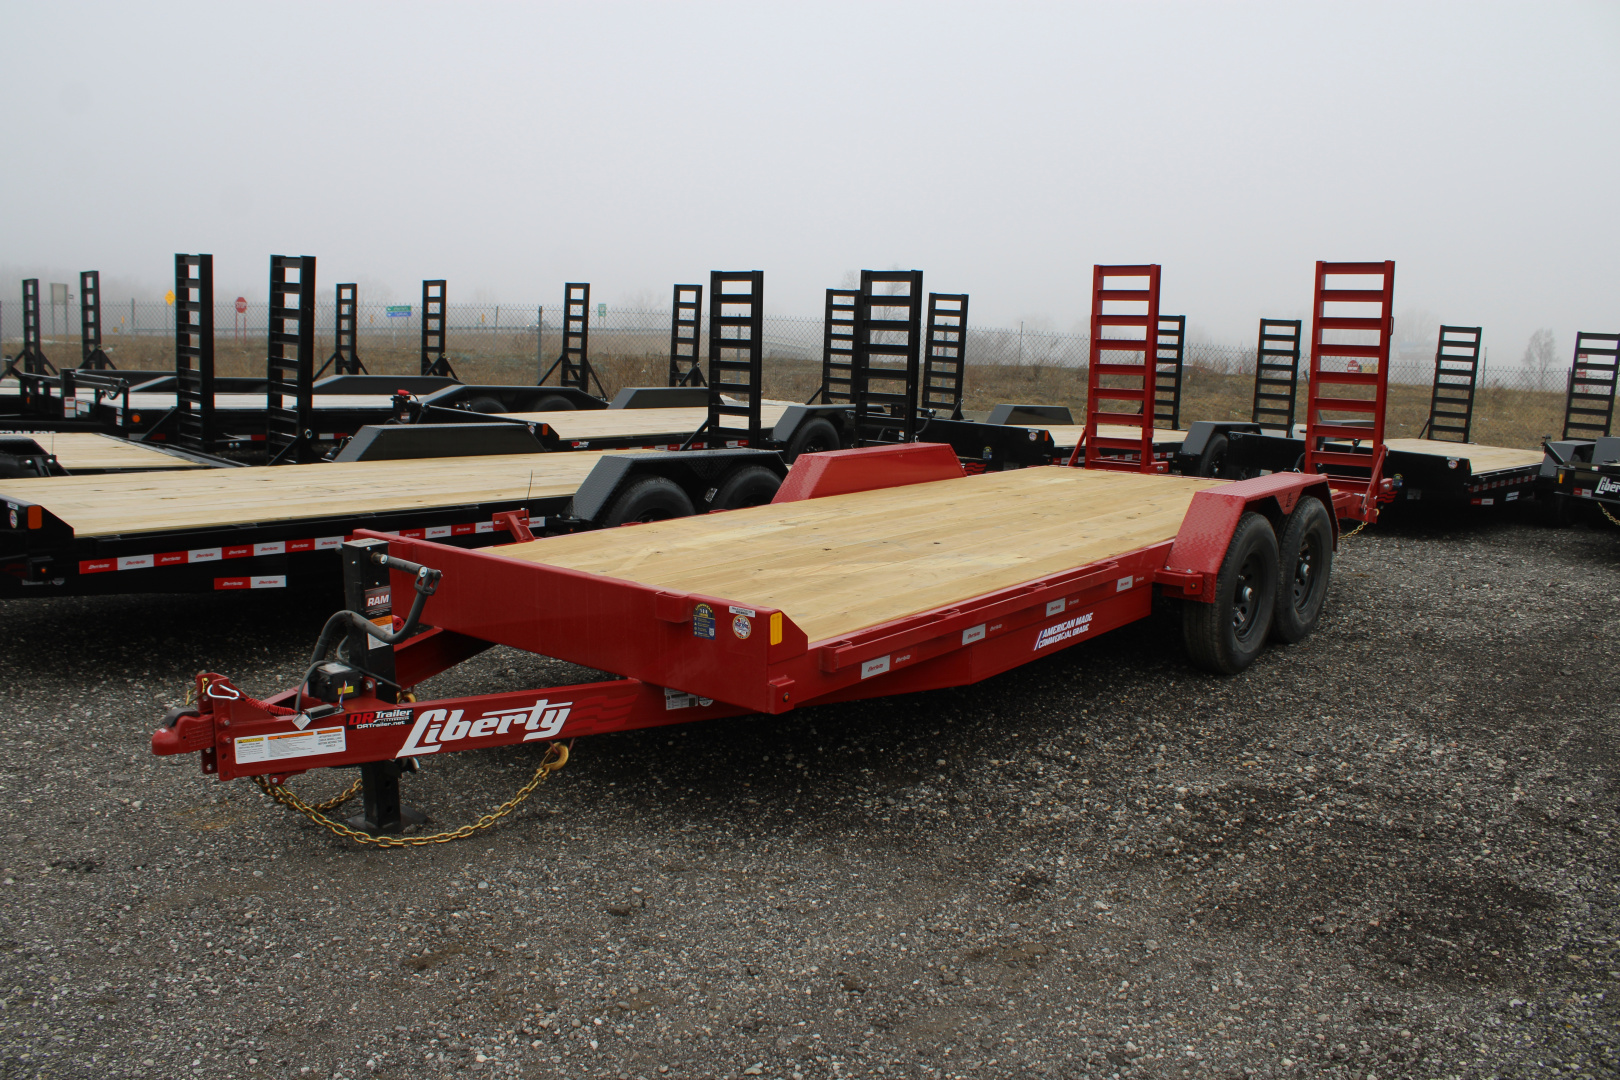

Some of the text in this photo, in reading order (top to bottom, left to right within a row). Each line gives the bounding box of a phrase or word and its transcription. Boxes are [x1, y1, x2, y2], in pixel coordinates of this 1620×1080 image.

[367, 594, 389, 607] RAM
[1042, 612, 1093, 638] AMERICAN MADE
[1038, 623, 1089, 649] COMMERCIAL GRADE
[348, 712, 375, 725] DR
[375, 709, 412, 719] Trailer
[356, 720, 406, 729] DRTrailer.net
[396, 699, 573, 759] Liberty
